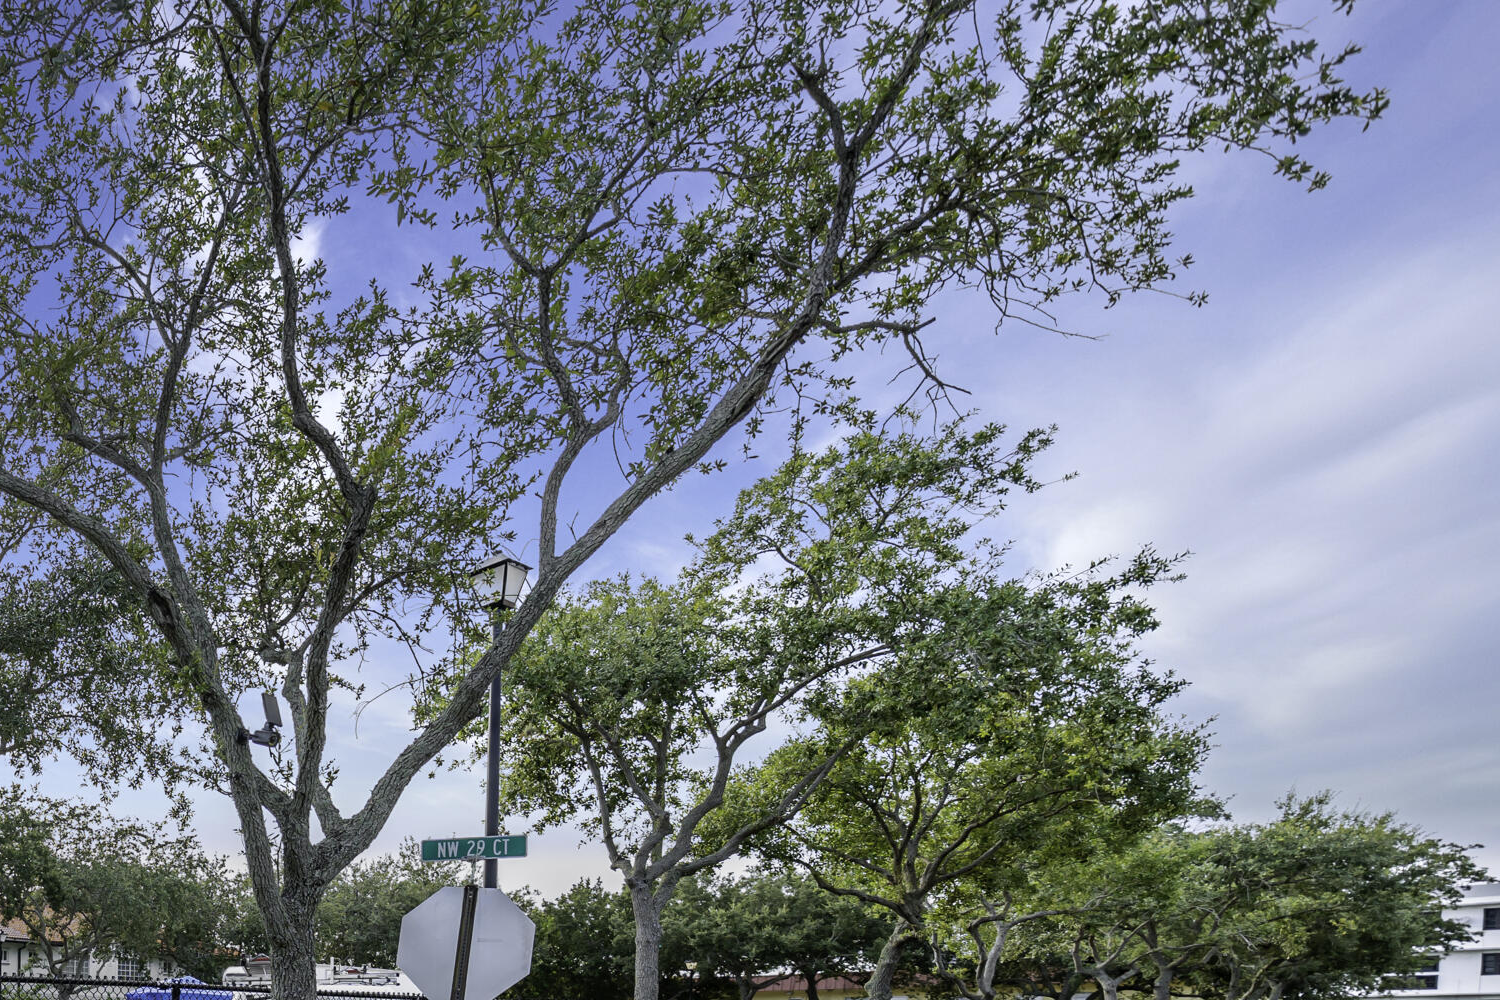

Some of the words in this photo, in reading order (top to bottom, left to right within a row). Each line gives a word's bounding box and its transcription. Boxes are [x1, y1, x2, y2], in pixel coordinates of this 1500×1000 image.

[437, 842, 459, 858] NW
[467, 840, 485, 857] 29
[493, 839, 510, 856] CT
